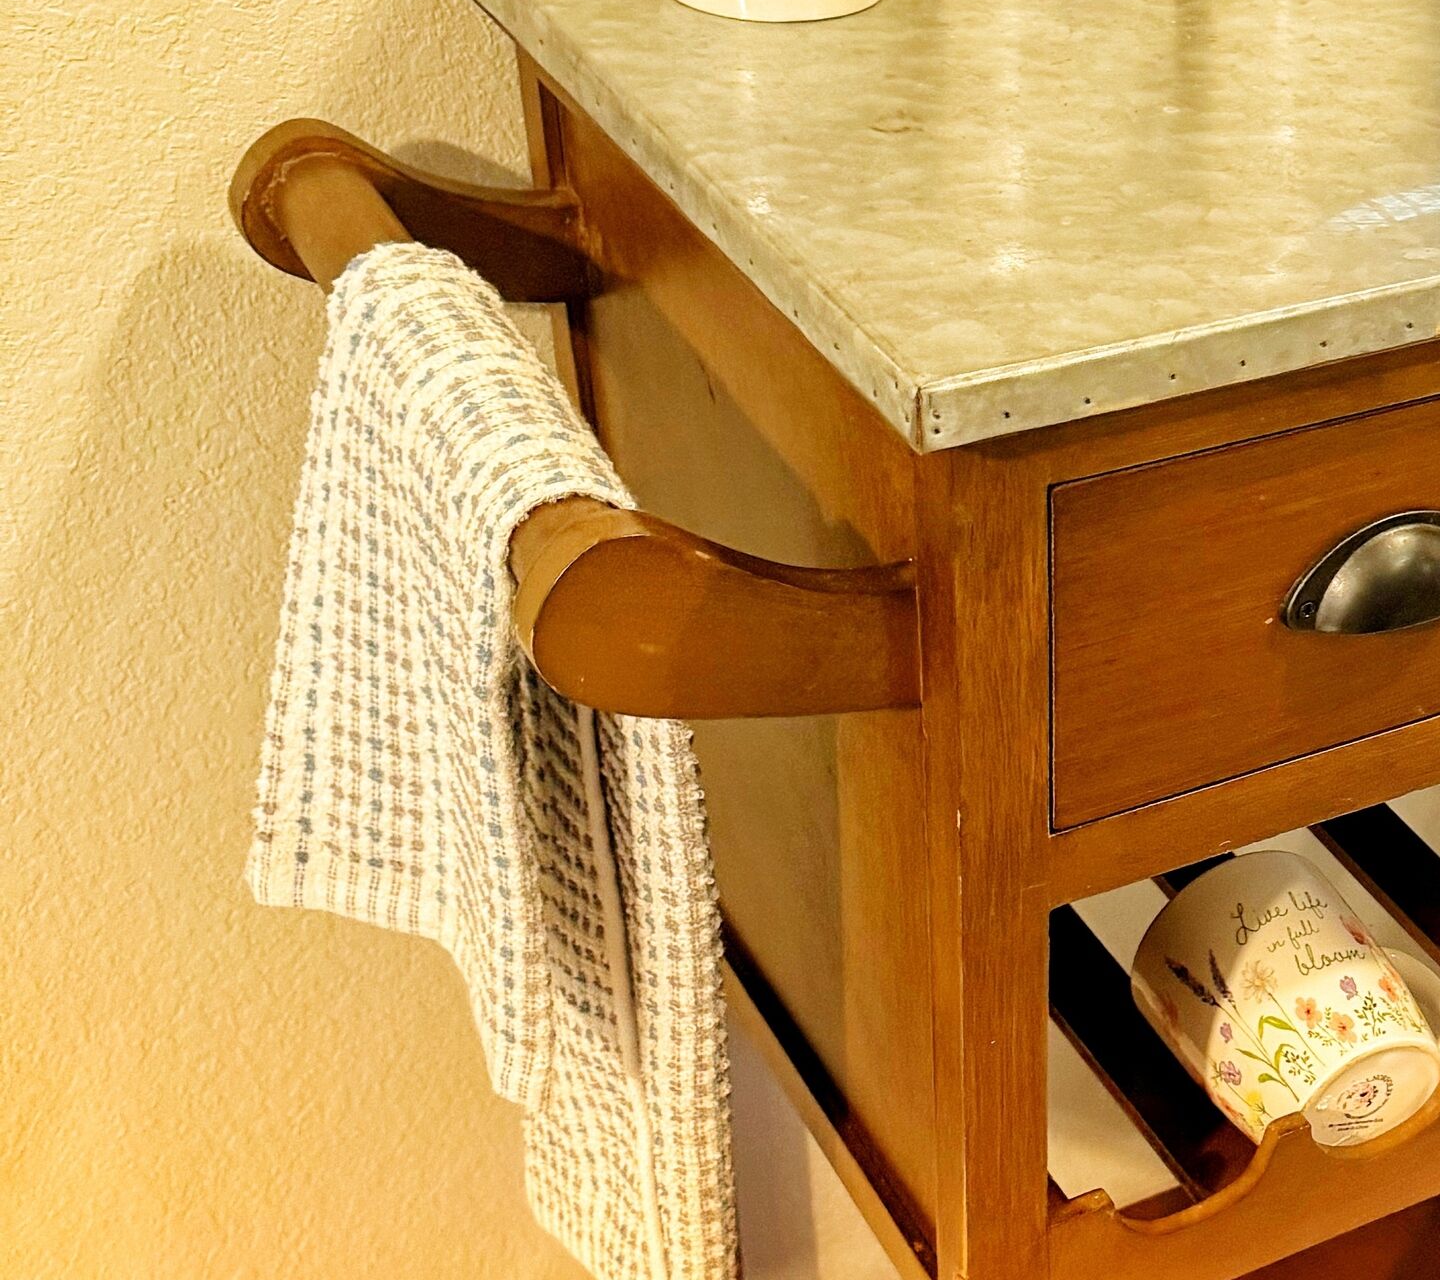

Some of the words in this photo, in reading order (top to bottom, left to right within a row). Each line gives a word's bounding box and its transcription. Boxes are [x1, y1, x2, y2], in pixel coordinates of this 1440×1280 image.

[1230, 902, 1288, 946] Live
[1287, 891, 1328, 919] life
[1266, 939, 1285, 953] in
[1286, 920, 1320, 950] full
[1294, 943, 1366, 976] bloom
